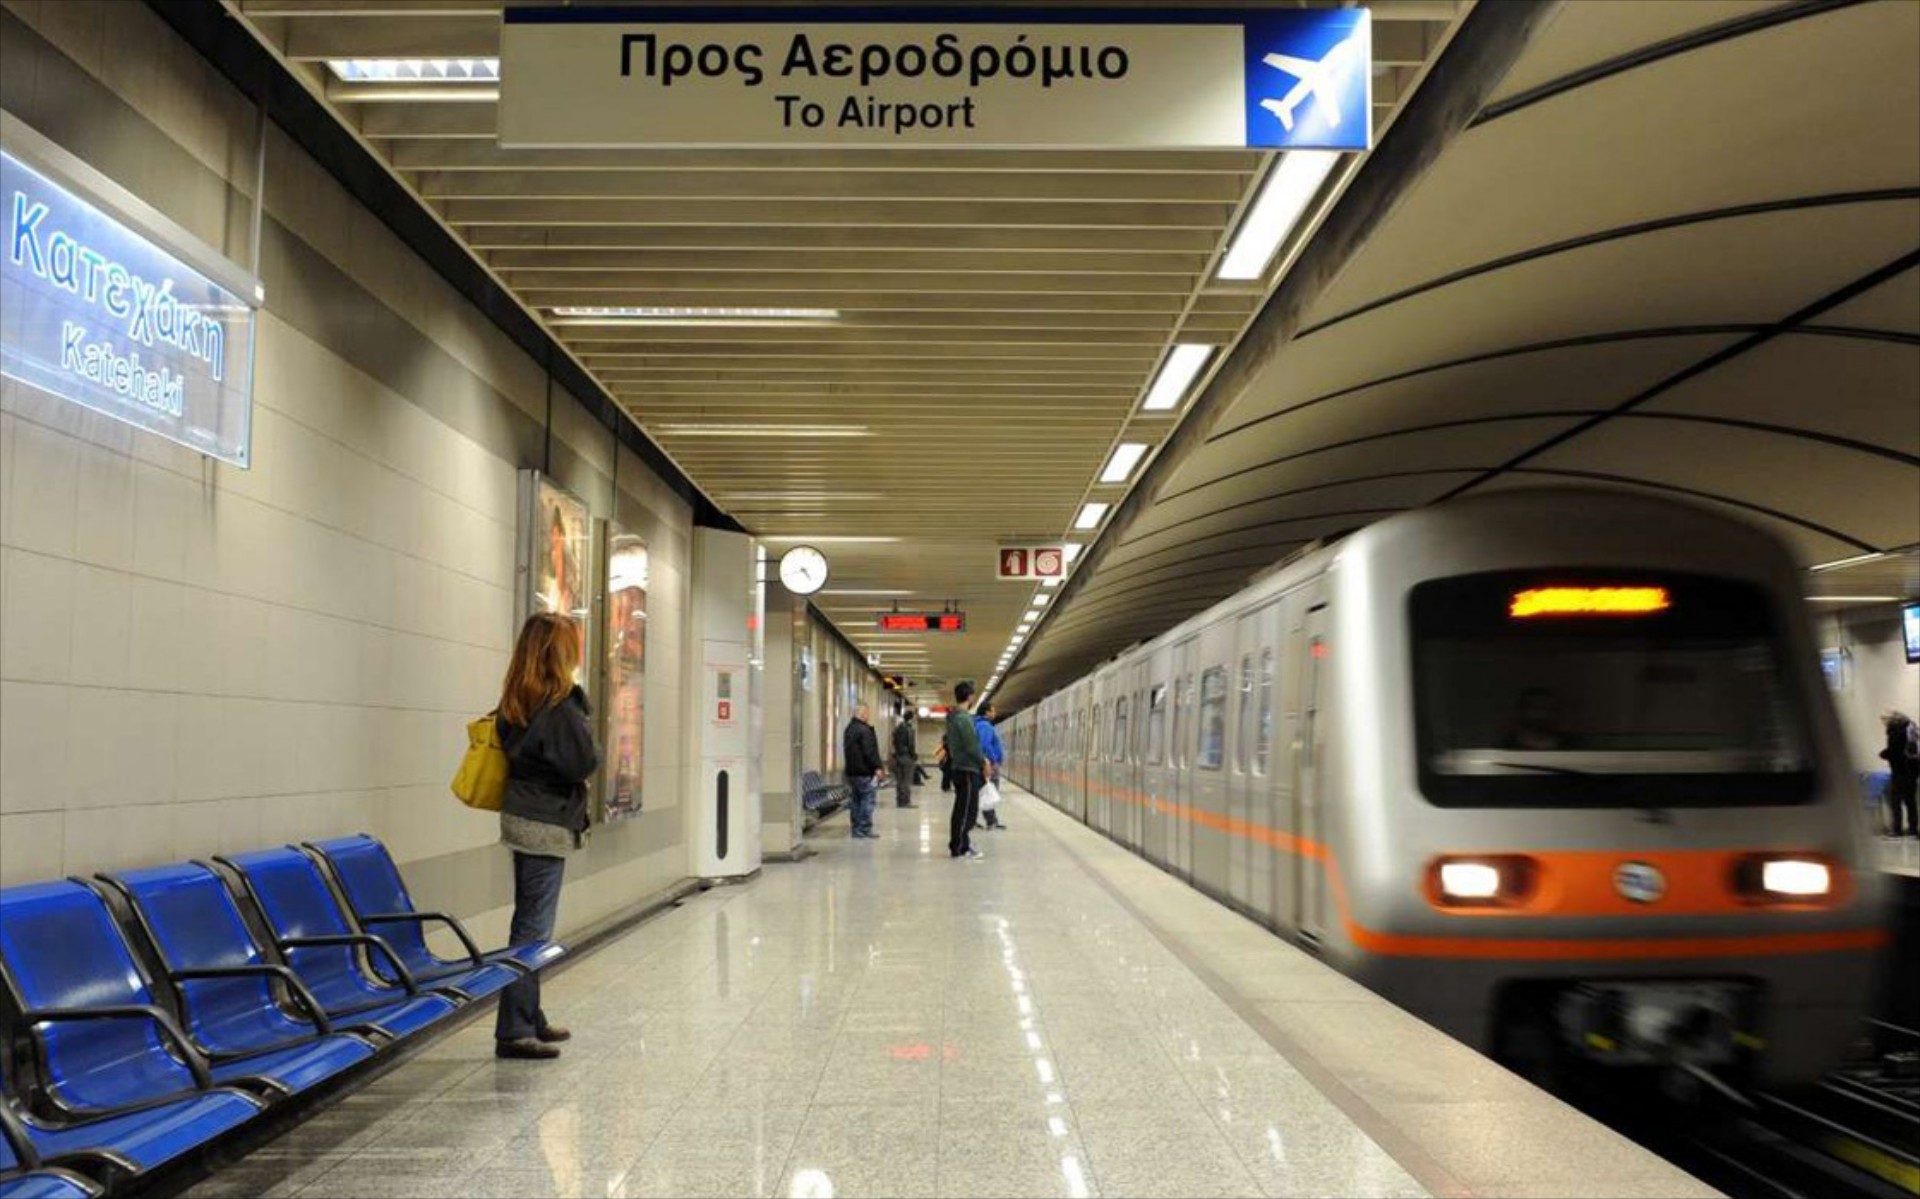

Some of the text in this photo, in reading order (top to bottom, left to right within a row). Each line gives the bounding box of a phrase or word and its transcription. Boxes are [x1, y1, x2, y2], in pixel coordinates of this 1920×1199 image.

[620, 33, 1129, 88] Προς Αεροδρόμιο
[775, 95, 976, 135] To Airport
[10, 191, 225, 381] Κατεχάκη
[61, 321, 185, 416] Katehaki
